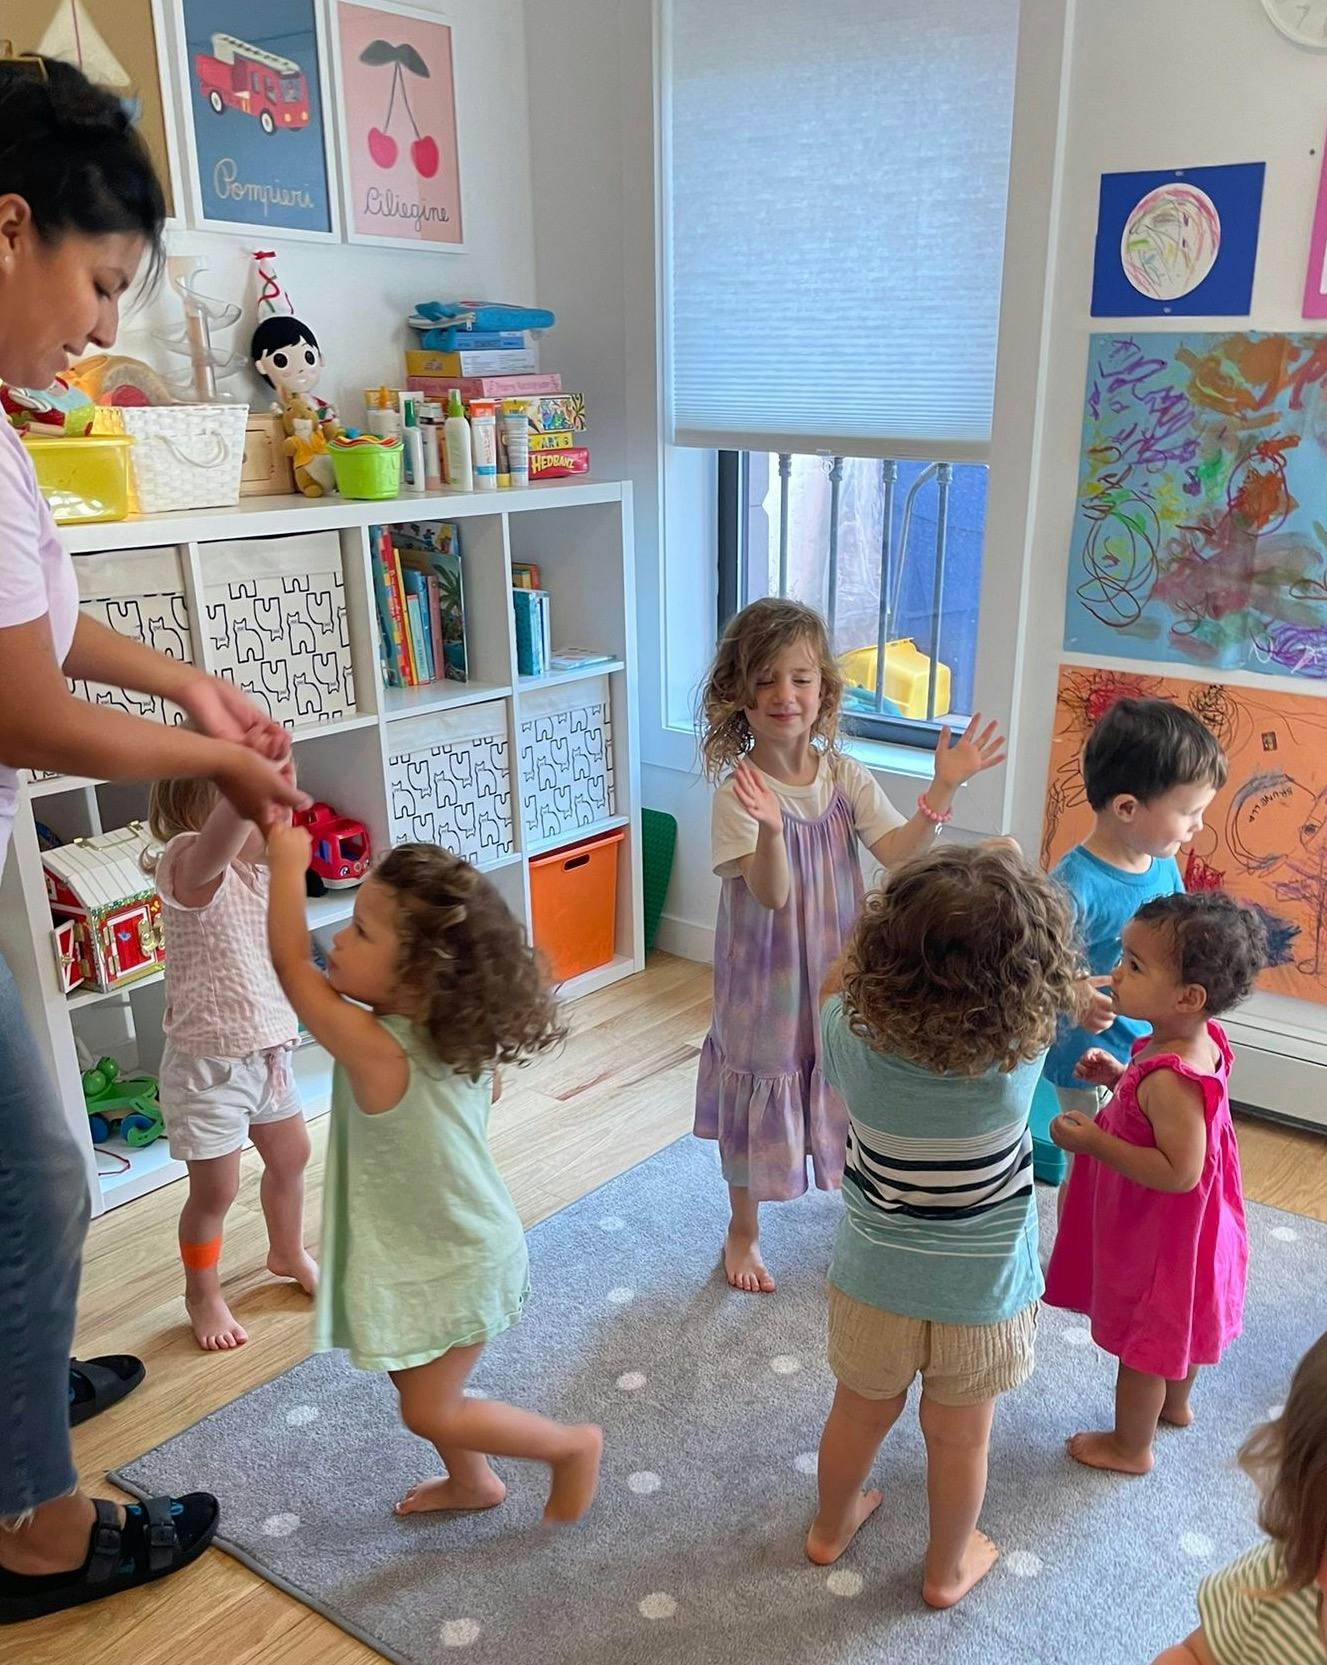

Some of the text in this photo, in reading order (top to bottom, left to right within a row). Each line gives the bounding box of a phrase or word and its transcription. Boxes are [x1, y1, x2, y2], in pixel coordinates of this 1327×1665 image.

[1295, 4, 1311, 30] 7
[214, 158, 314, 216] Pompieri
[364, 187, 450, 231] Ciliegine
[530, 454, 575, 474] HEDBANZ
